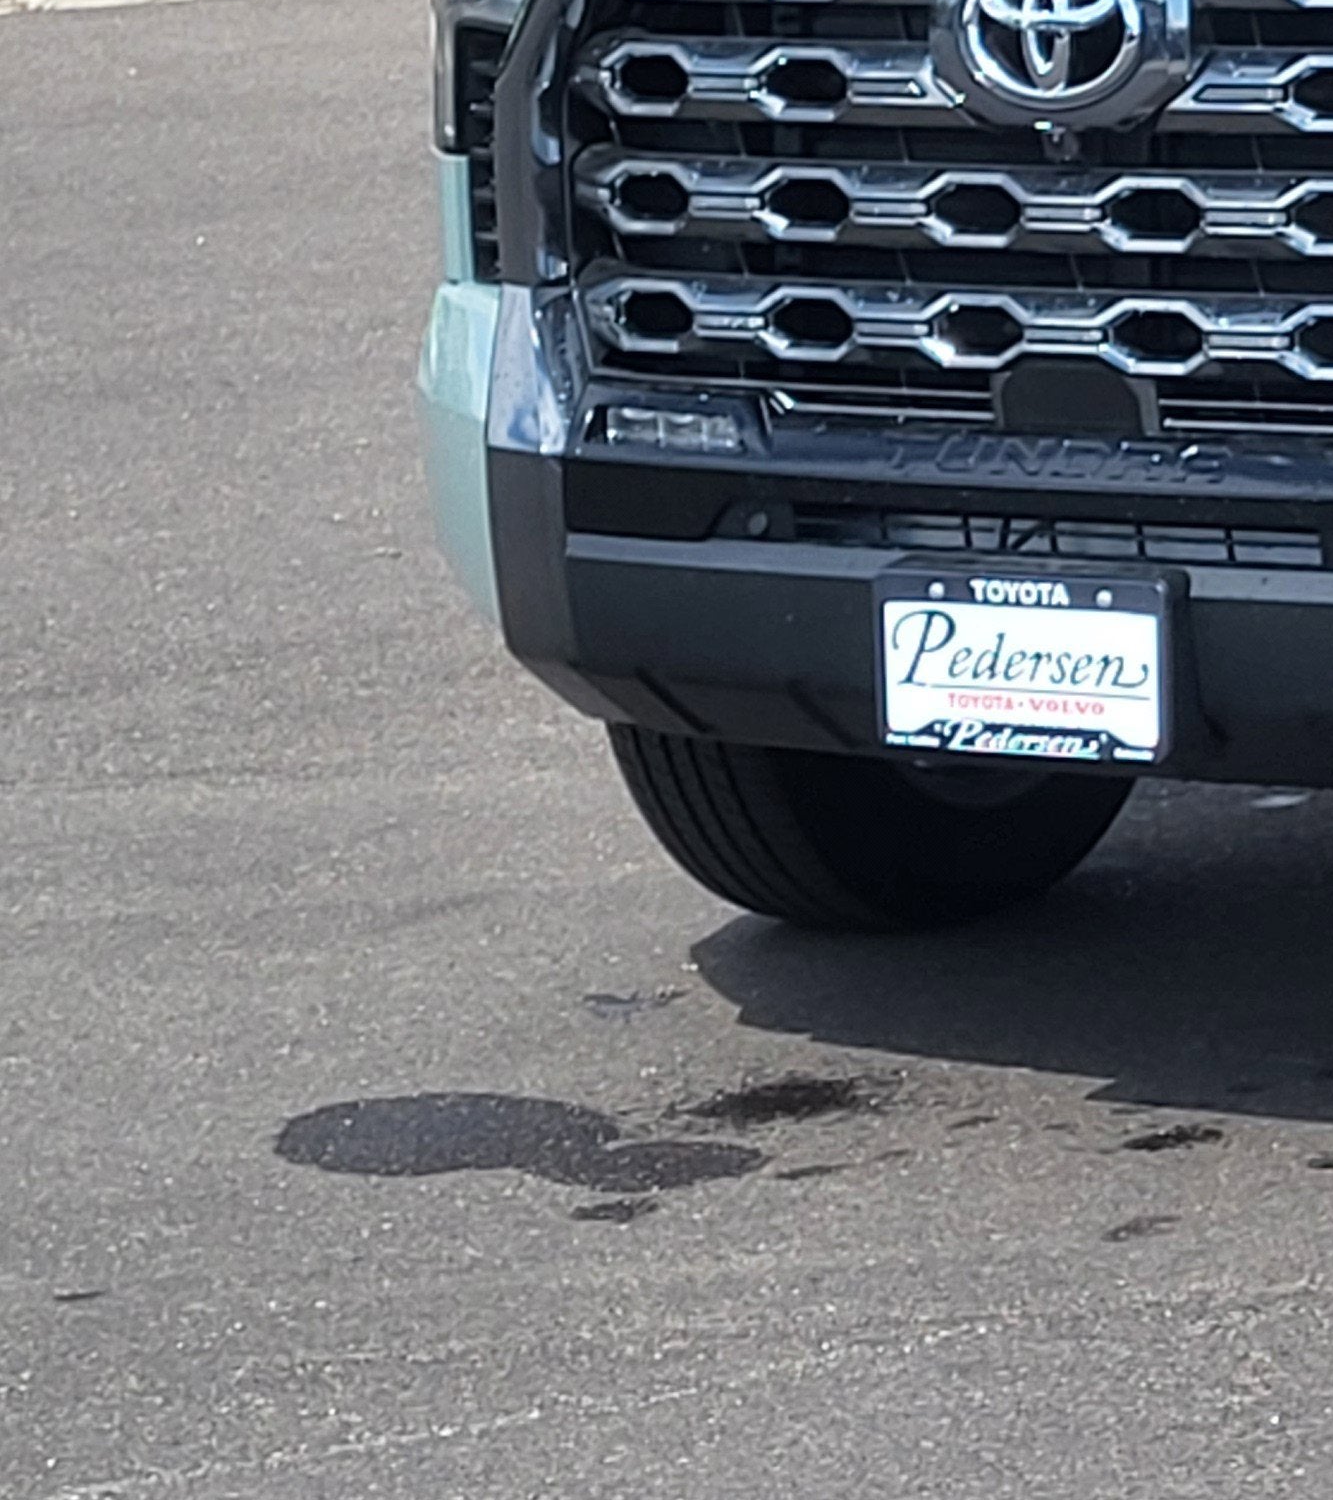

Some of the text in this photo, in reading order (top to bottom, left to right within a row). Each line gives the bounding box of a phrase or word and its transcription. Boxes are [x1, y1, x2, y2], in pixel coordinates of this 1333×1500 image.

[969, 579, 1070, 606] TOYOTA
[892, 609, 1149, 689] Pedersen
[948, 692, 1105, 716] TOYOTA VOLVO
